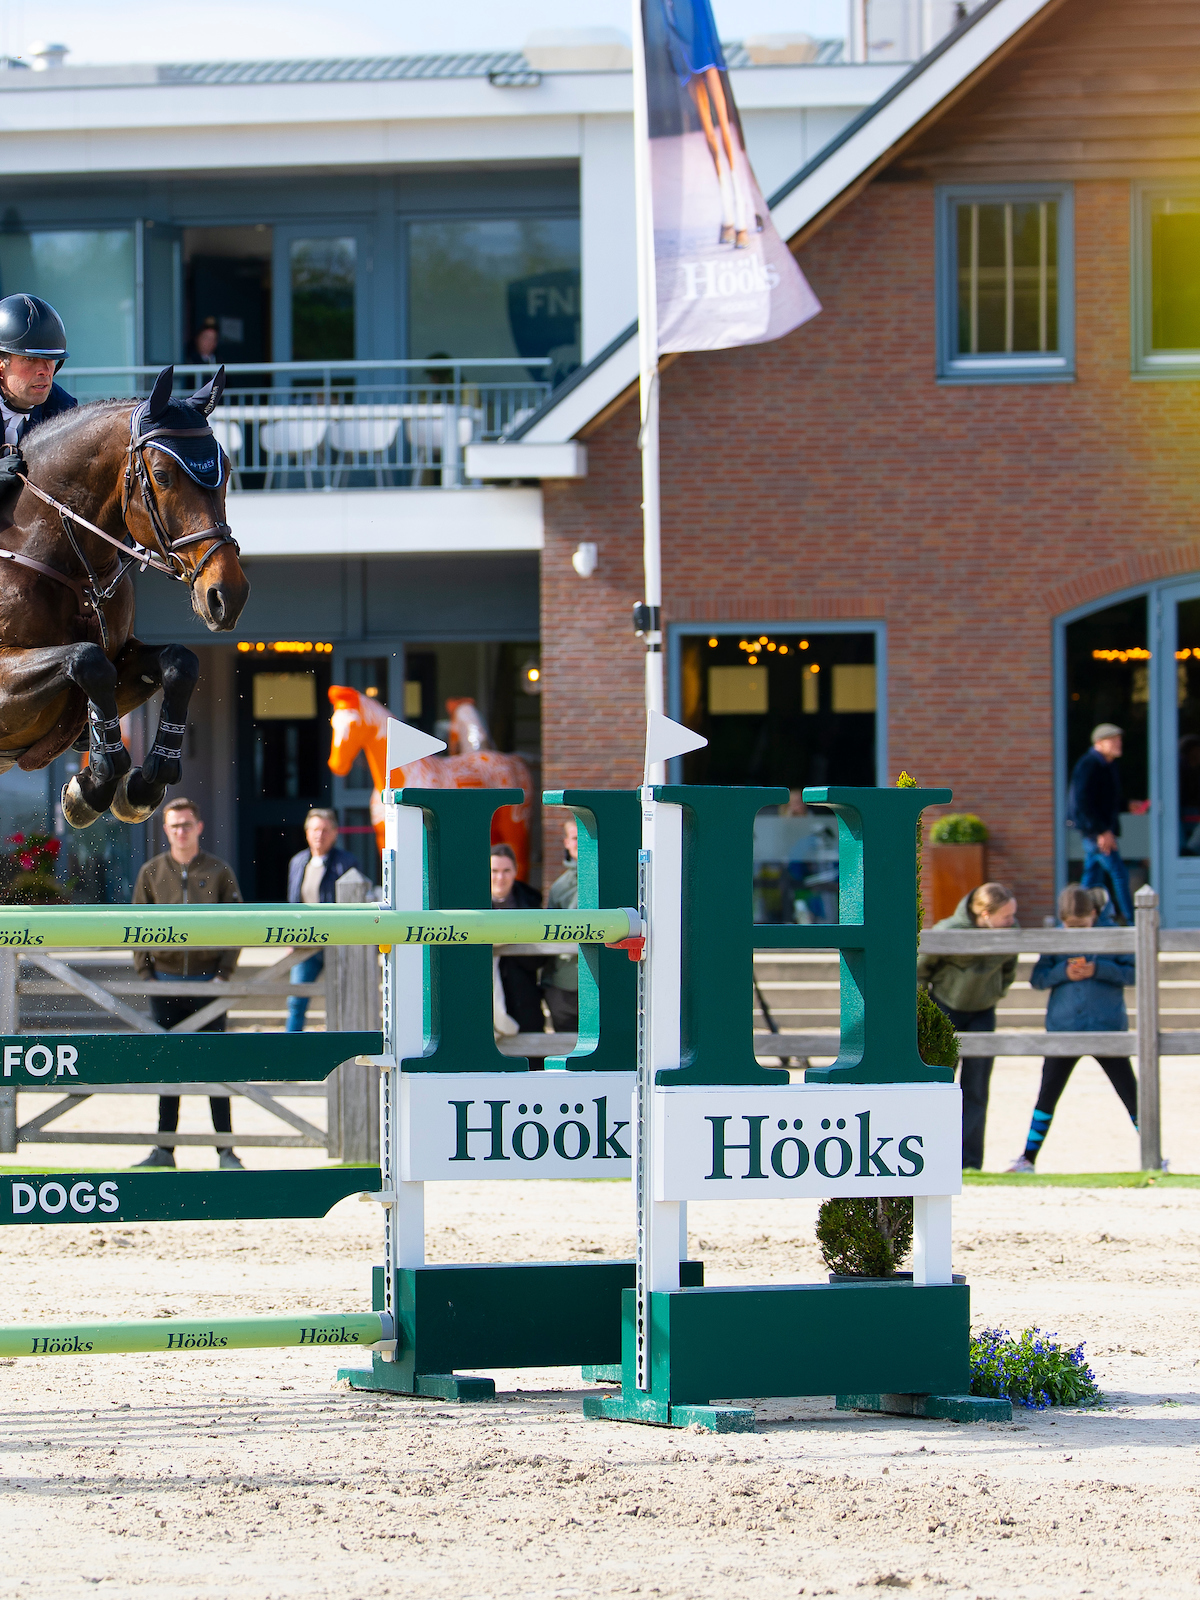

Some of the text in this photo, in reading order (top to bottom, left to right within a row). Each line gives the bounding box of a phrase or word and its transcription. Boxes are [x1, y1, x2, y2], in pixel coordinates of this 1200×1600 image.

[681, 254, 781, 301] Hööks
[122, 926, 189, 943] Hööks
[264, 926, 330, 943] Hööks
[404, 925, 469, 942] Hööks
[541, 923, 606, 940] Hööks
[3, 1042, 79, 1078] FOR
[704, 1110, 925, 1180] Hööks
[11, 1180, 120, 1214] DOGS
[30, 1335, 94, 1353] Hööks
[166, 1330, 228, 1349] Hööks
[299, 1326, 360, 1344] Hööks
